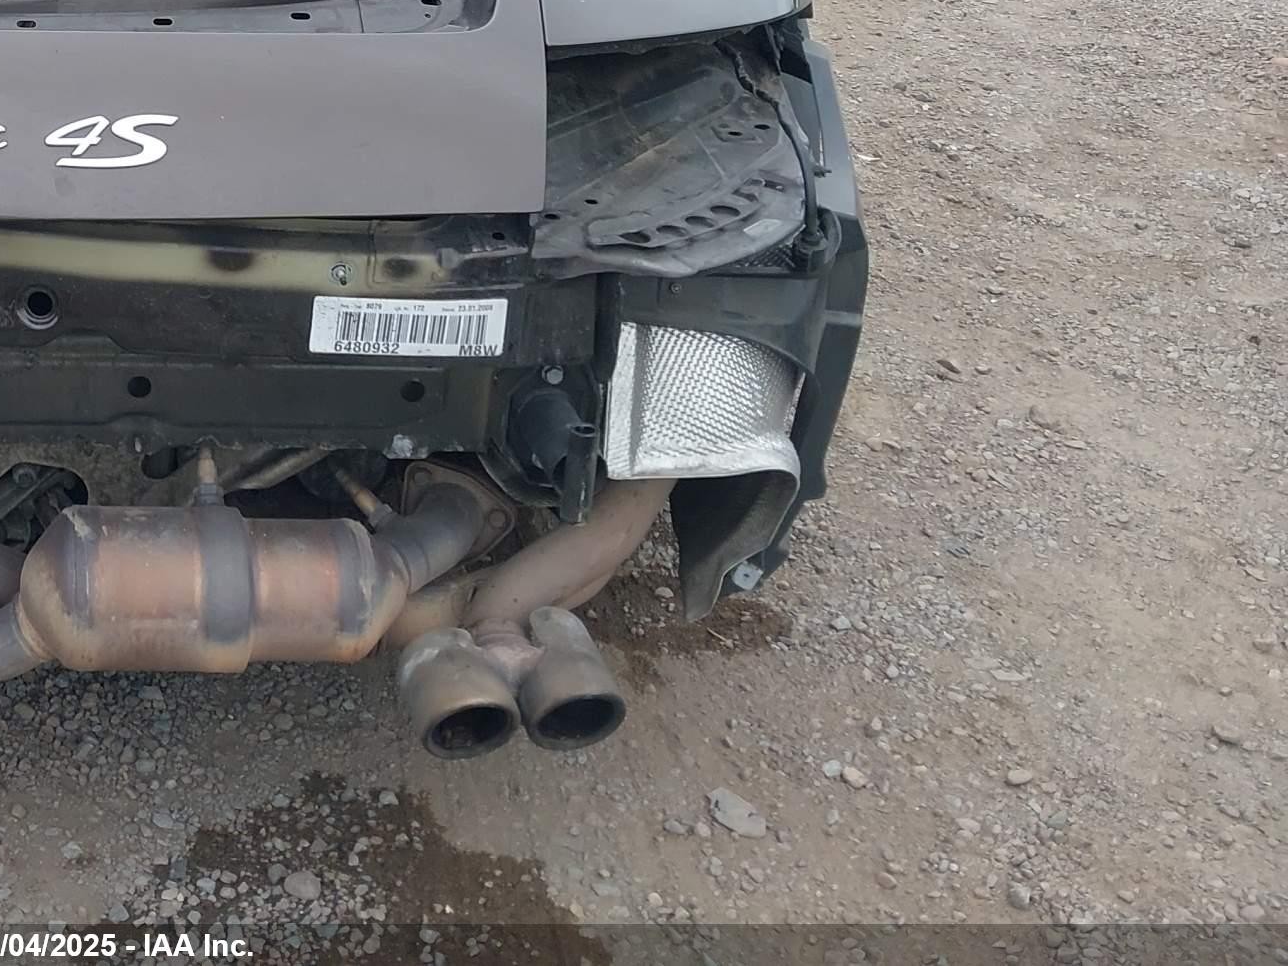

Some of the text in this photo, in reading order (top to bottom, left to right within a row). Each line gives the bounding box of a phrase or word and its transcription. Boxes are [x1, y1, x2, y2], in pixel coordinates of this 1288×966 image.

[44, 113, 179, 169] 4S
[334, 340, 498, 357] 6480932 M8W
